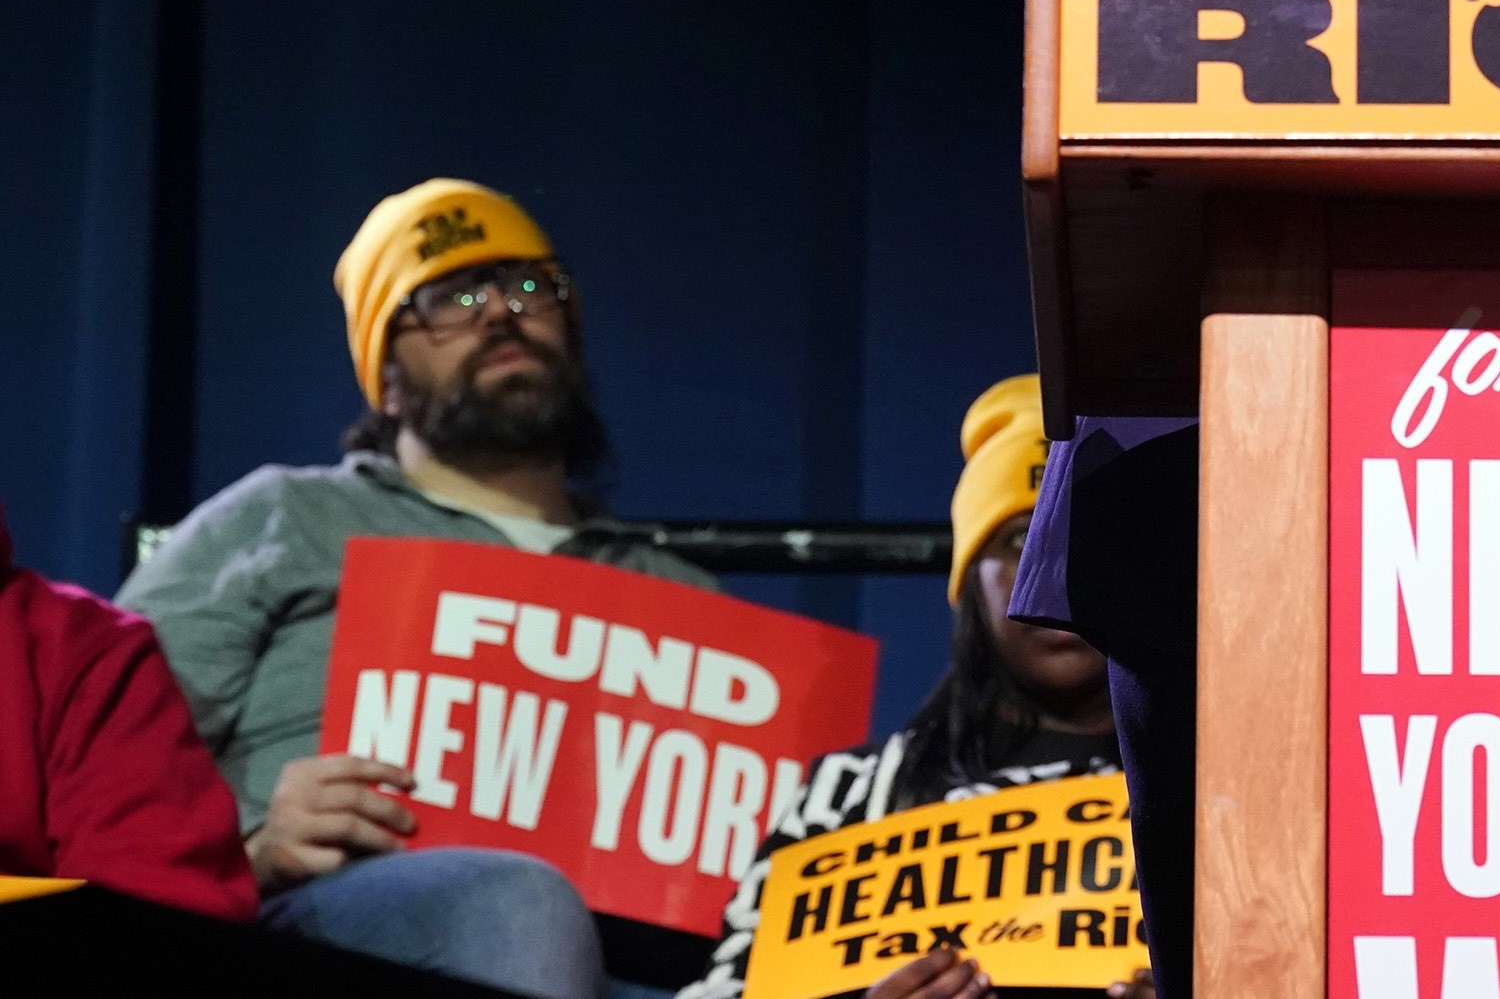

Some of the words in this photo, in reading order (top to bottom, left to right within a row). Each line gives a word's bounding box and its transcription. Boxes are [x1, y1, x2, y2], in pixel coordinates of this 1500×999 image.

[431, 591, 781, 727] FUND
[347, 668, 569, 831] NEW
[787, 836, 1140, 944] HEALTHC
[800, 810, 1037, 878] CHILD
[1066, 800, 1131, 824] C
[833, 922, 968, 967] Tax
[978, 917, 1045, 945] the
